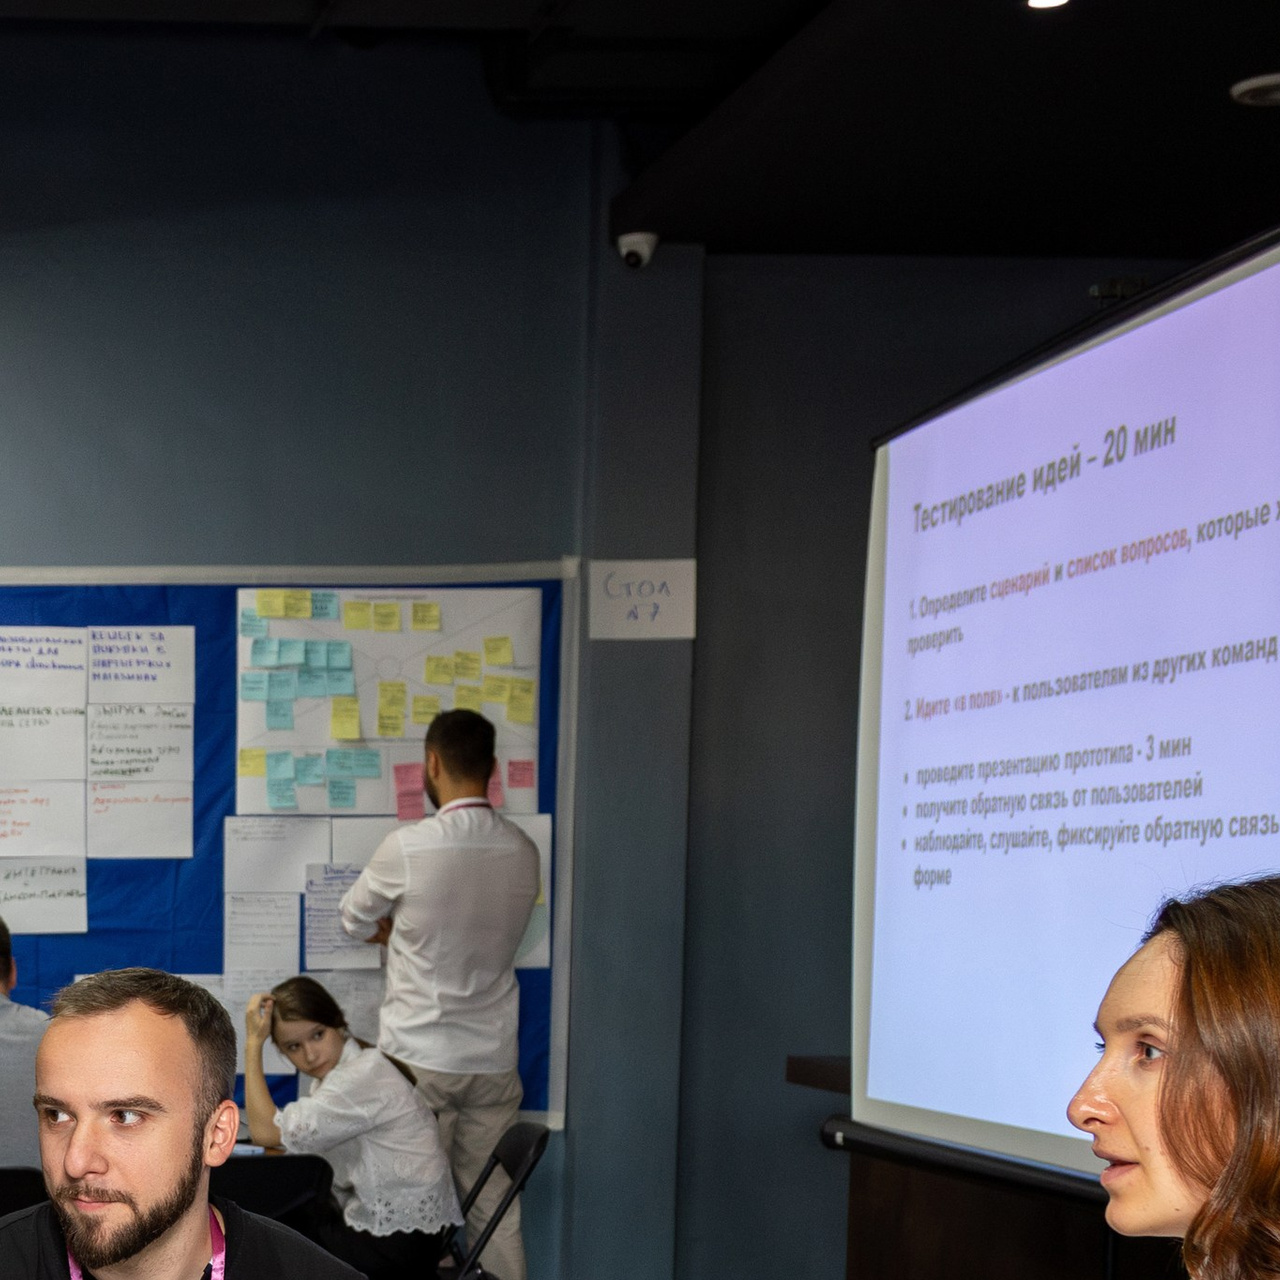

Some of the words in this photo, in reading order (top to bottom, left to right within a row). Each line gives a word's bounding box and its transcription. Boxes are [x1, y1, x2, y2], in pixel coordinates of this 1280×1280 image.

[913, 472, 1026, 534] Тестирование
[1033, 443, 1081, 495] идей
[1103, 424, 1128, 468] 20
[1134, 415, 1177, 457] мин
[920, 584, 987, 621] Определите
[990, 561, 1051, 601] сценарий
[1054, 561, 1063, 582] и
[1066, 546, 1117, 580] список
[1121, 526, 1192, 565] вопросов,
[1196, 505, 1271, 545] которые
[907, 624, 964, 654] проверить
[915, 695, 950, 721] Идите
[1012, 686, 1021, 704] к
[1023, 664, 1129, 703] пользователям
[1132, 660, 1150, 684] из
[1153, 648, 1207, 685] других
[1211, 634, 1279, 669] команд
[917, 761, 975, 789] проведите
[977, 750, 1061, 782] презентацию
[1064, 742, 1134, 776] прототипа
[1146, 733, 1155, 763] 3
[1159, 735, 1193, 760] мин
[916, 797, 968, 823] получите
[970, 791, 1028, 820] обратную
[1030, 788, 1070, 812] связь
[1072, 787, 1088, 809] от
[1091, 770, 1204, 805] пользователей
[914, 828, 988, 855] наблюдайте,
[990, 824, 1054, 855] слушайте,
[1056, 814, 1141, 853] фиксируйте
[1144, 813, 1224, 848] обратную
[1228, 812, 1280, 838] связь
[913, 863, 953, 888] форме
